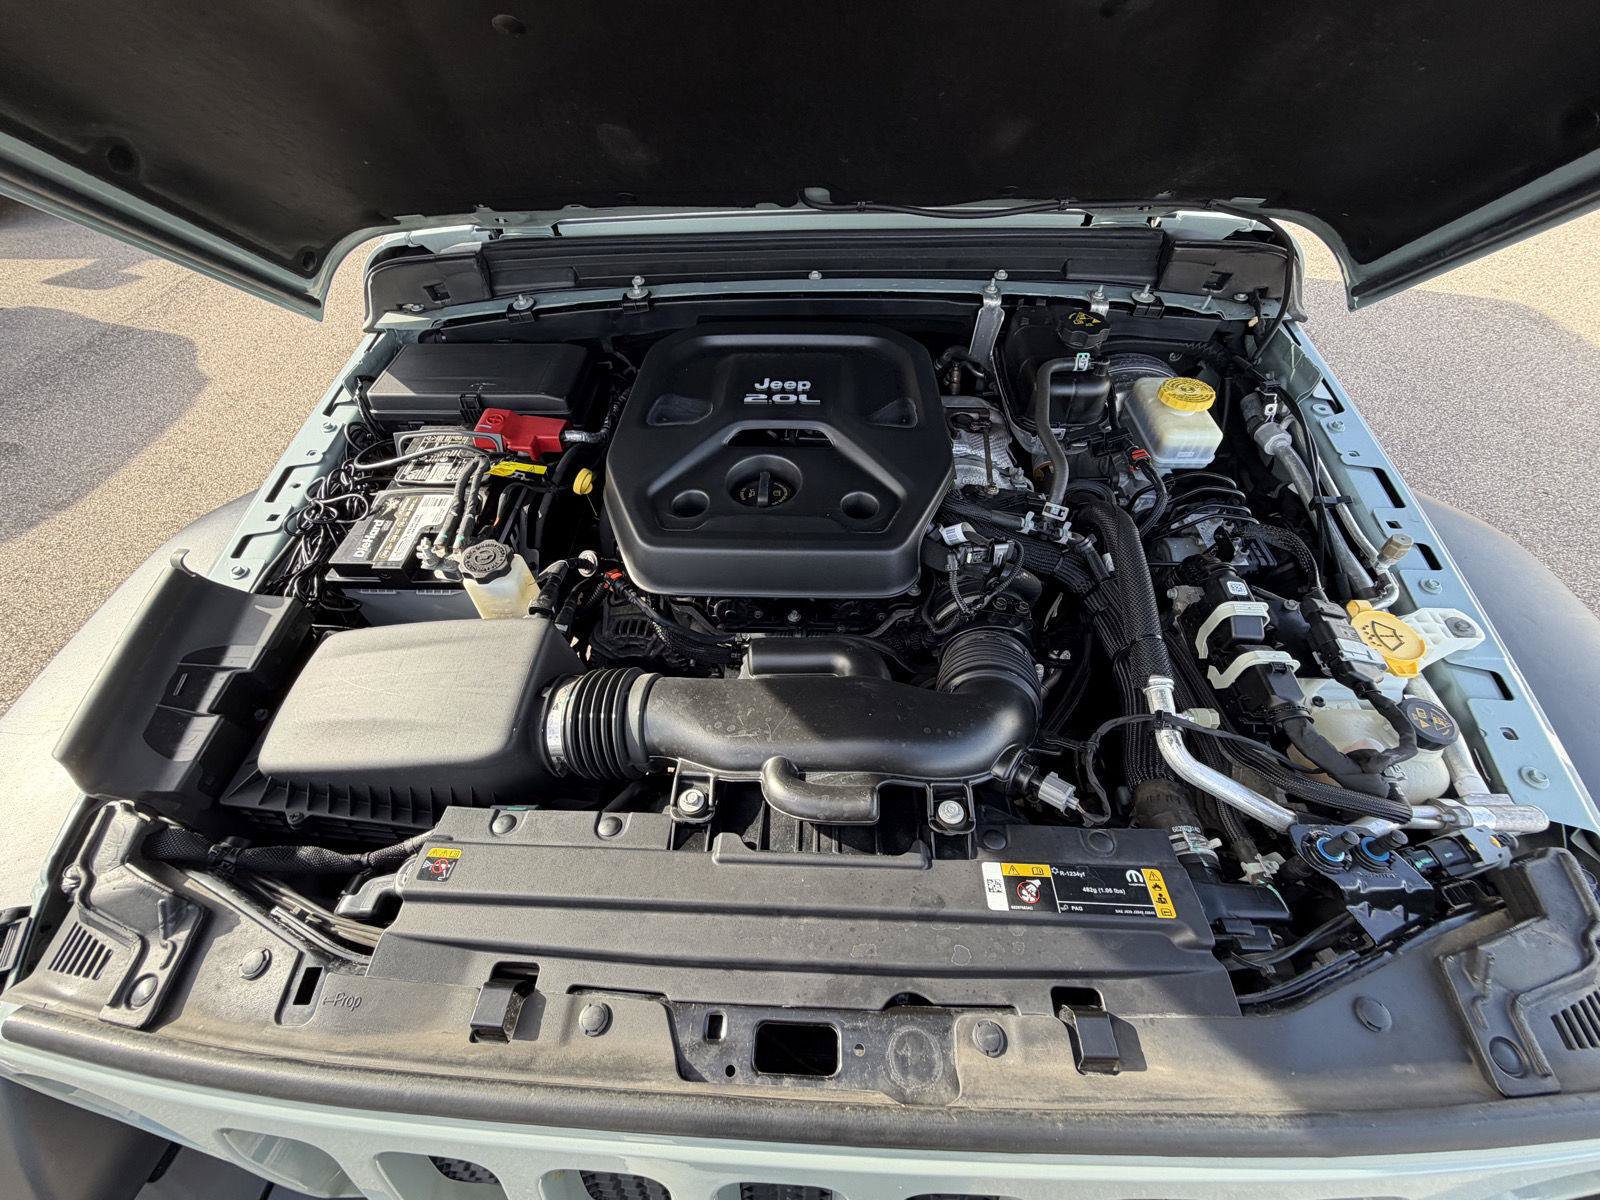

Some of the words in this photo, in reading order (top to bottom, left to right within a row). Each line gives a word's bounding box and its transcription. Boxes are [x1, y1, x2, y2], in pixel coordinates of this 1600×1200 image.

[754, 378, 811, 391] Jeep
[743, 394, 820, 405] 2.0L
[353, 519, 384, 558] DieHard
[333, 992, 362, 1011] Prop
